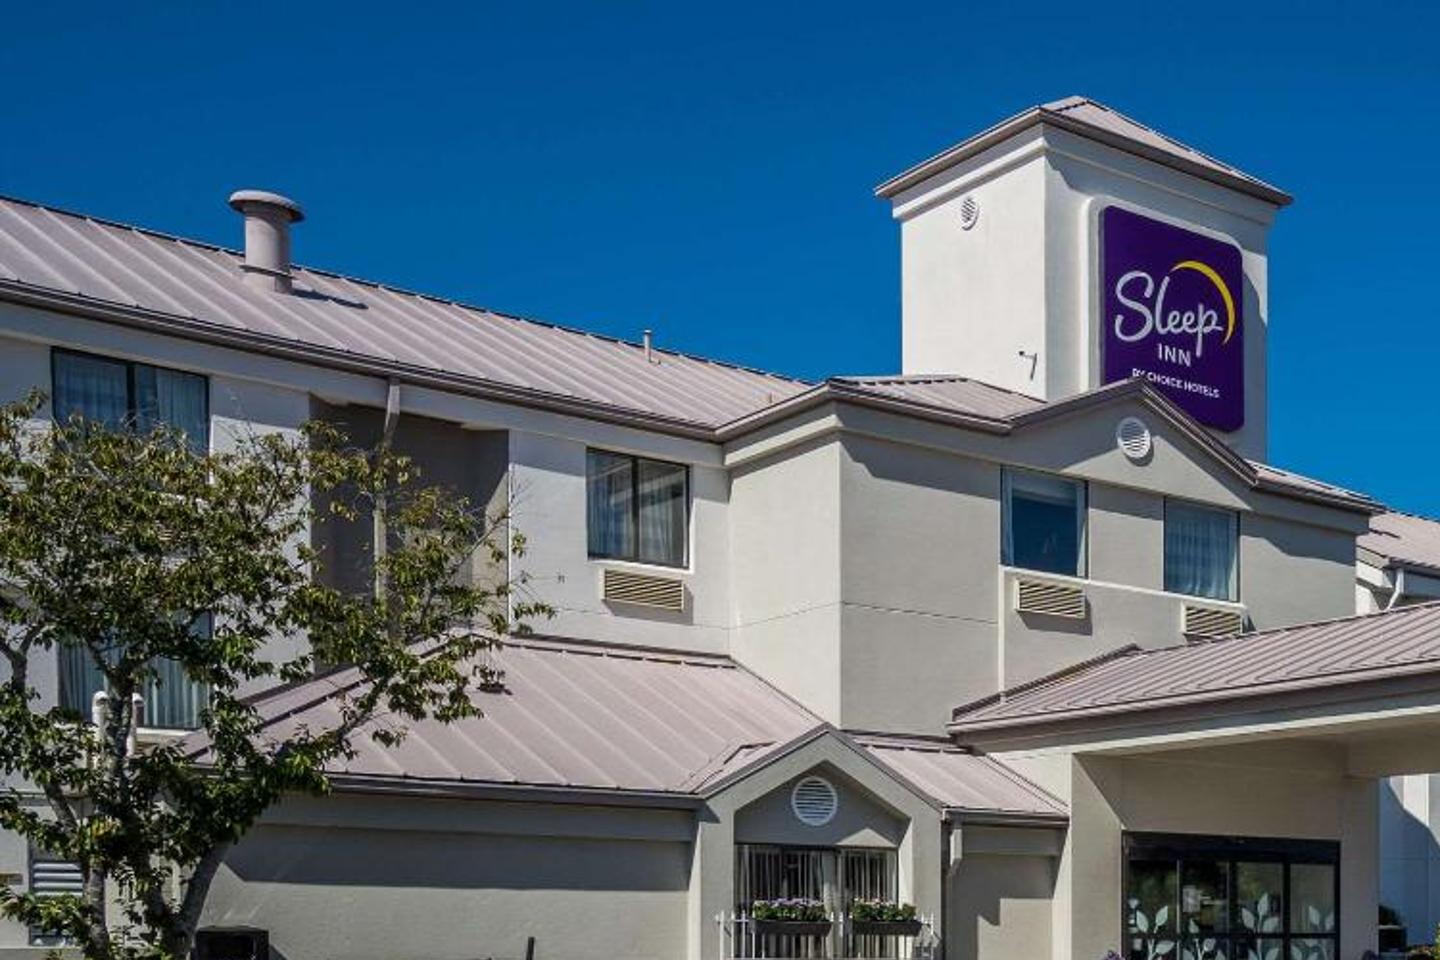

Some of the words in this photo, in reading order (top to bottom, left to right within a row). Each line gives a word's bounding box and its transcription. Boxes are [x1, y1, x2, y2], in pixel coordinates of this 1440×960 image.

[1115, 270, 1223, 358] Sleep
[1158, 343, 1191, 367] INN
[1147, 372, 1182, 388] CHOICE
[1184, 381, 1219, 398] HOTELS
